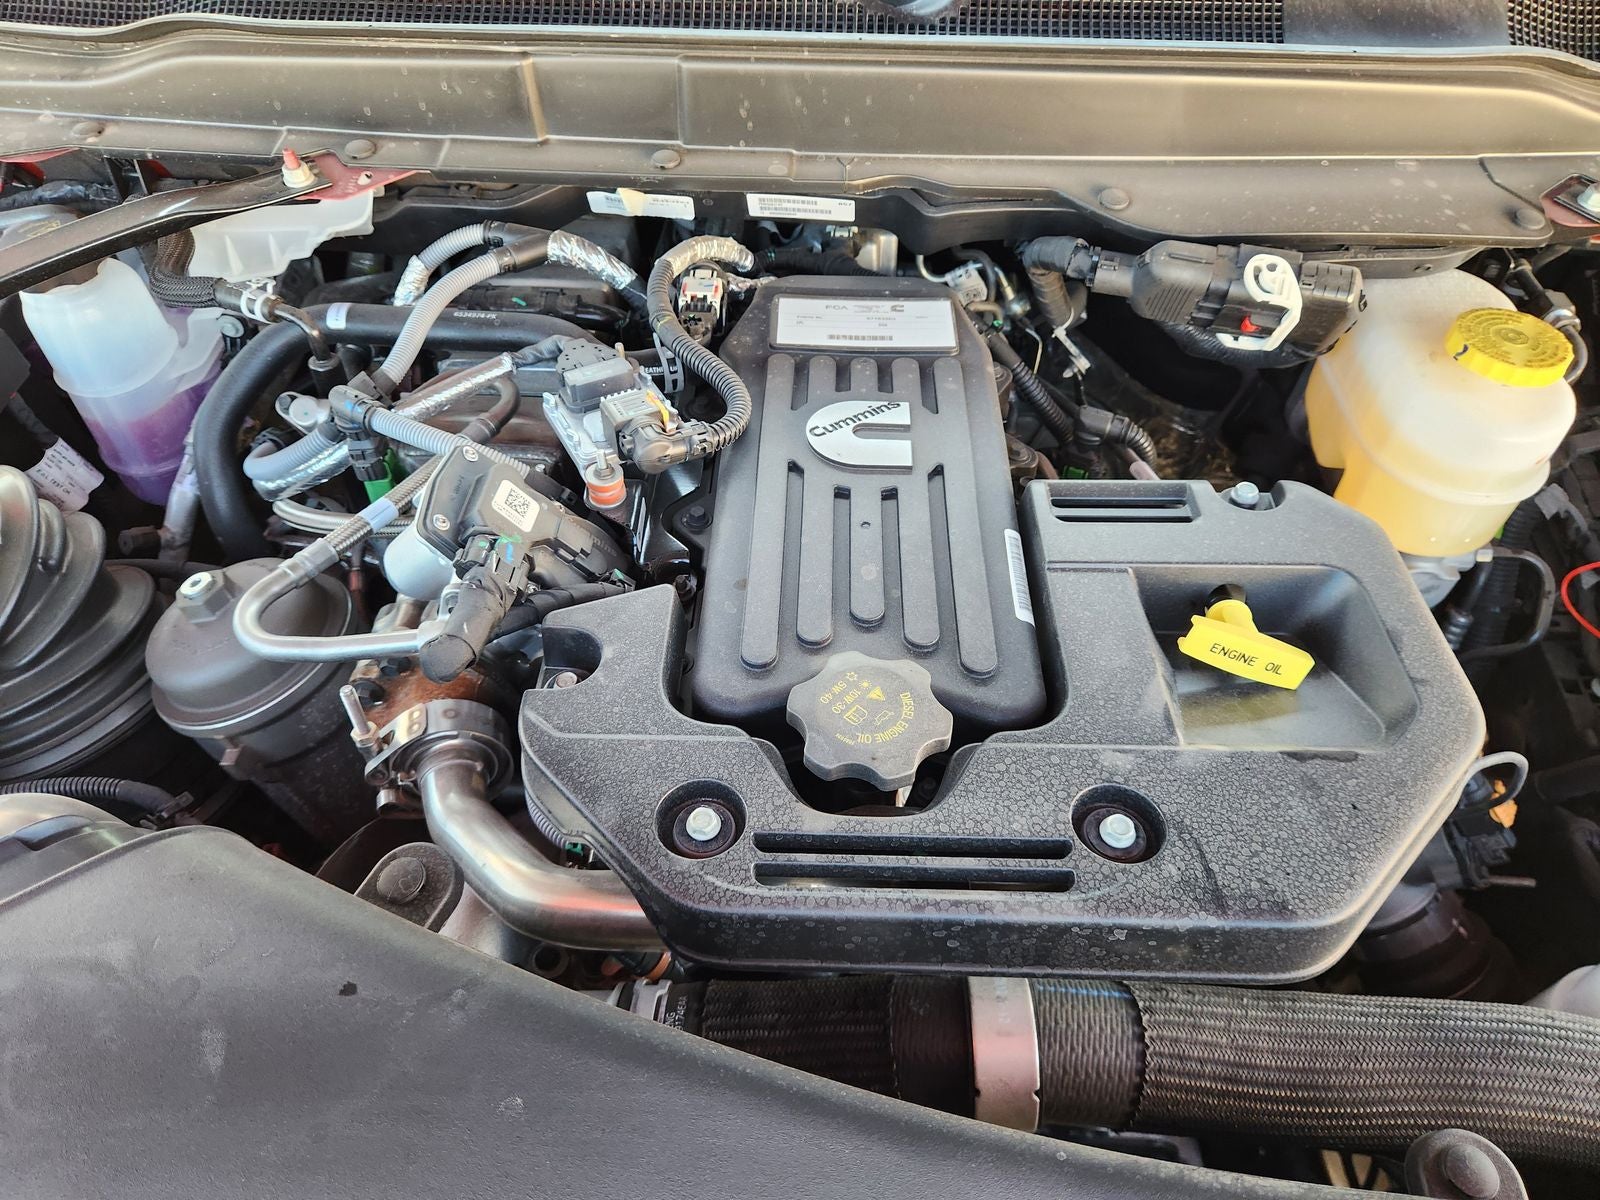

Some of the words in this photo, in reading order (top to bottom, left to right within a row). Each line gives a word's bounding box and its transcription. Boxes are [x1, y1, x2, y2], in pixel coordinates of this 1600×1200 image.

[809, 401, 901, 437] Cummins
[1209, 642, 1260, 667] ENGINE
[1264, 662, 1282, 675] OIL
[820, 680, 847, 704] 5W-40
[831, 689, 862, 714] 10W-30
[899, 691, 915, 722] DIESEL
[856, 732, 872, 744] OIL
[875, 721, 909, 744] ENGINE
